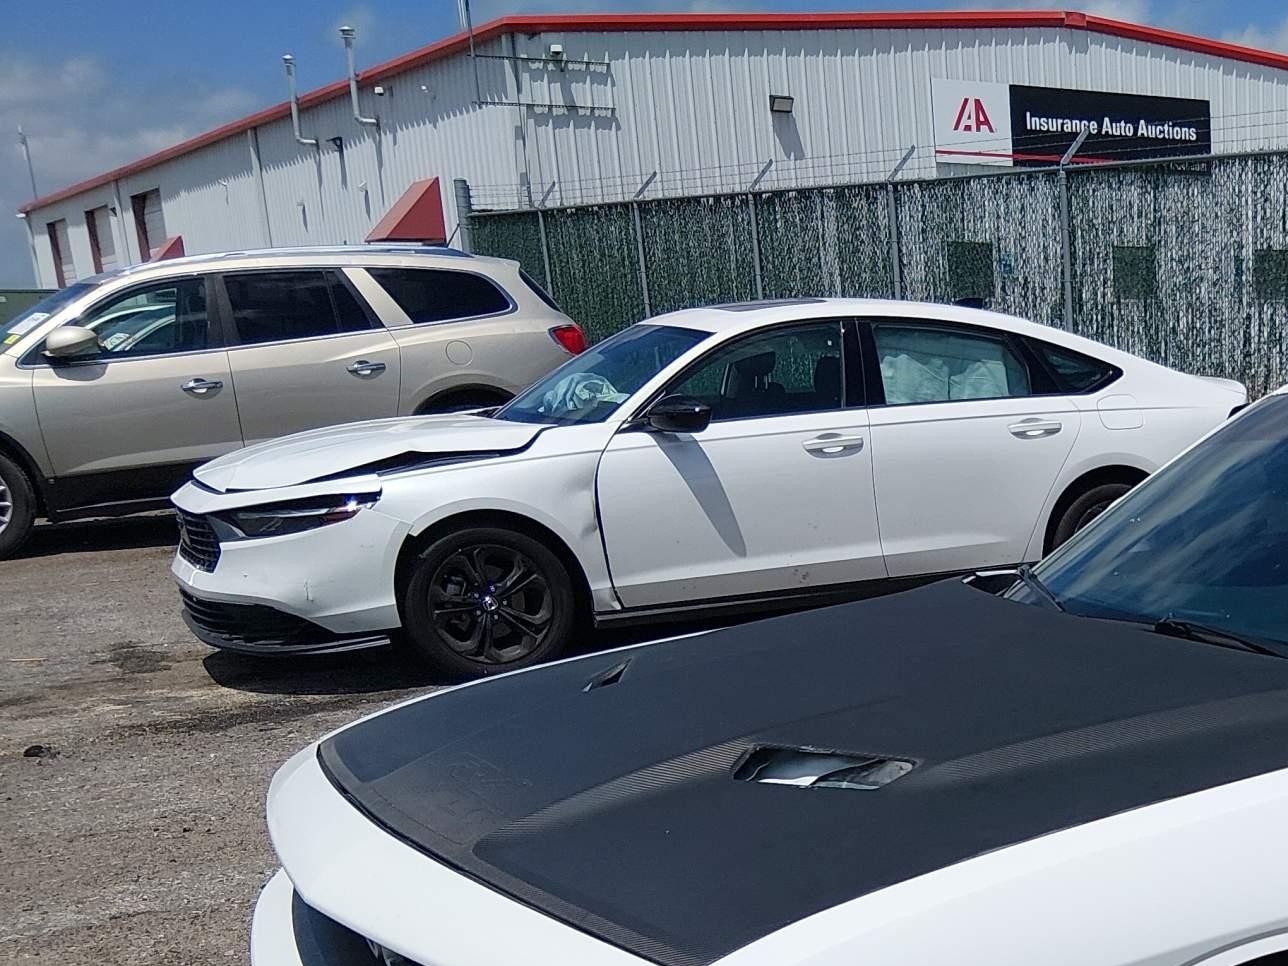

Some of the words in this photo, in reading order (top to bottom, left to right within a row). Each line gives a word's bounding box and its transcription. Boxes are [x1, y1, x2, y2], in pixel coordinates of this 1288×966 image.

[1026, 111, 1098, 134] Insurance
[1101, 117, 1134, 137] Auto
[1137, 120, 1197, 141] Auctions
